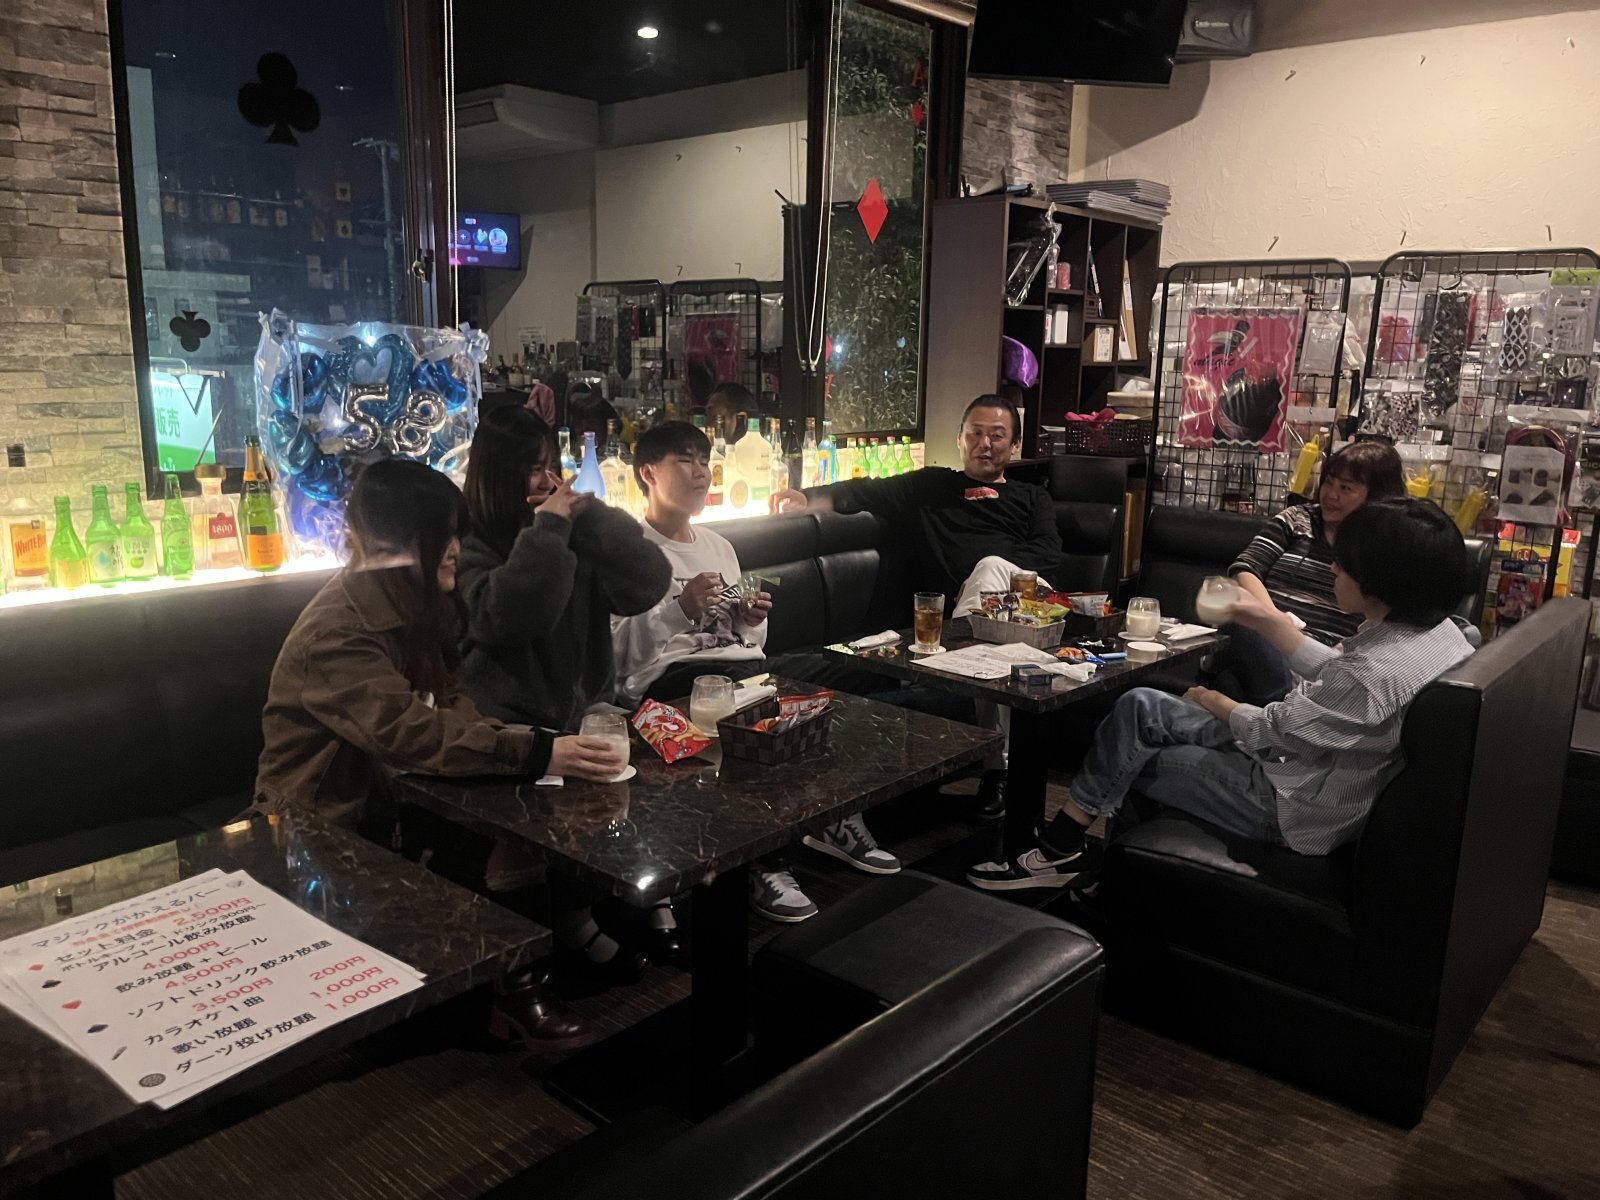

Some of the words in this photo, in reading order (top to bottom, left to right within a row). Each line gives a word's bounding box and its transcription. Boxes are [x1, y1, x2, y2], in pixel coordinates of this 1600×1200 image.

[212, 524, 233, 534] 1800
[32, 888, 220, 947] マジックがかえるバー
[54, 928, 157, 962] セット料金
[173, 897, 252, 926] 2,500円
[93, 913, 256, 971] アルコール飲み放題
[115, 961, 196, 993] 飲み放題
[217, 937, 268, 957] ビール
[128, 939, 333, 1018] ソフトドリンク飲み放題
[143, 940, 220, 971] 4,000円
[164, 957, 244, 990] 4,500円
[309, 955, 367, 981] 200円
[170, 1017, 257, 1055] 歌い放題
[309, 965, 384, 999] 1,000円
[191, 976, 274, 1012] 3,500円
[176, 1011, 317, 1074] ダーツ投げ放題
[325, 977, 400, 1011] 1,000円
